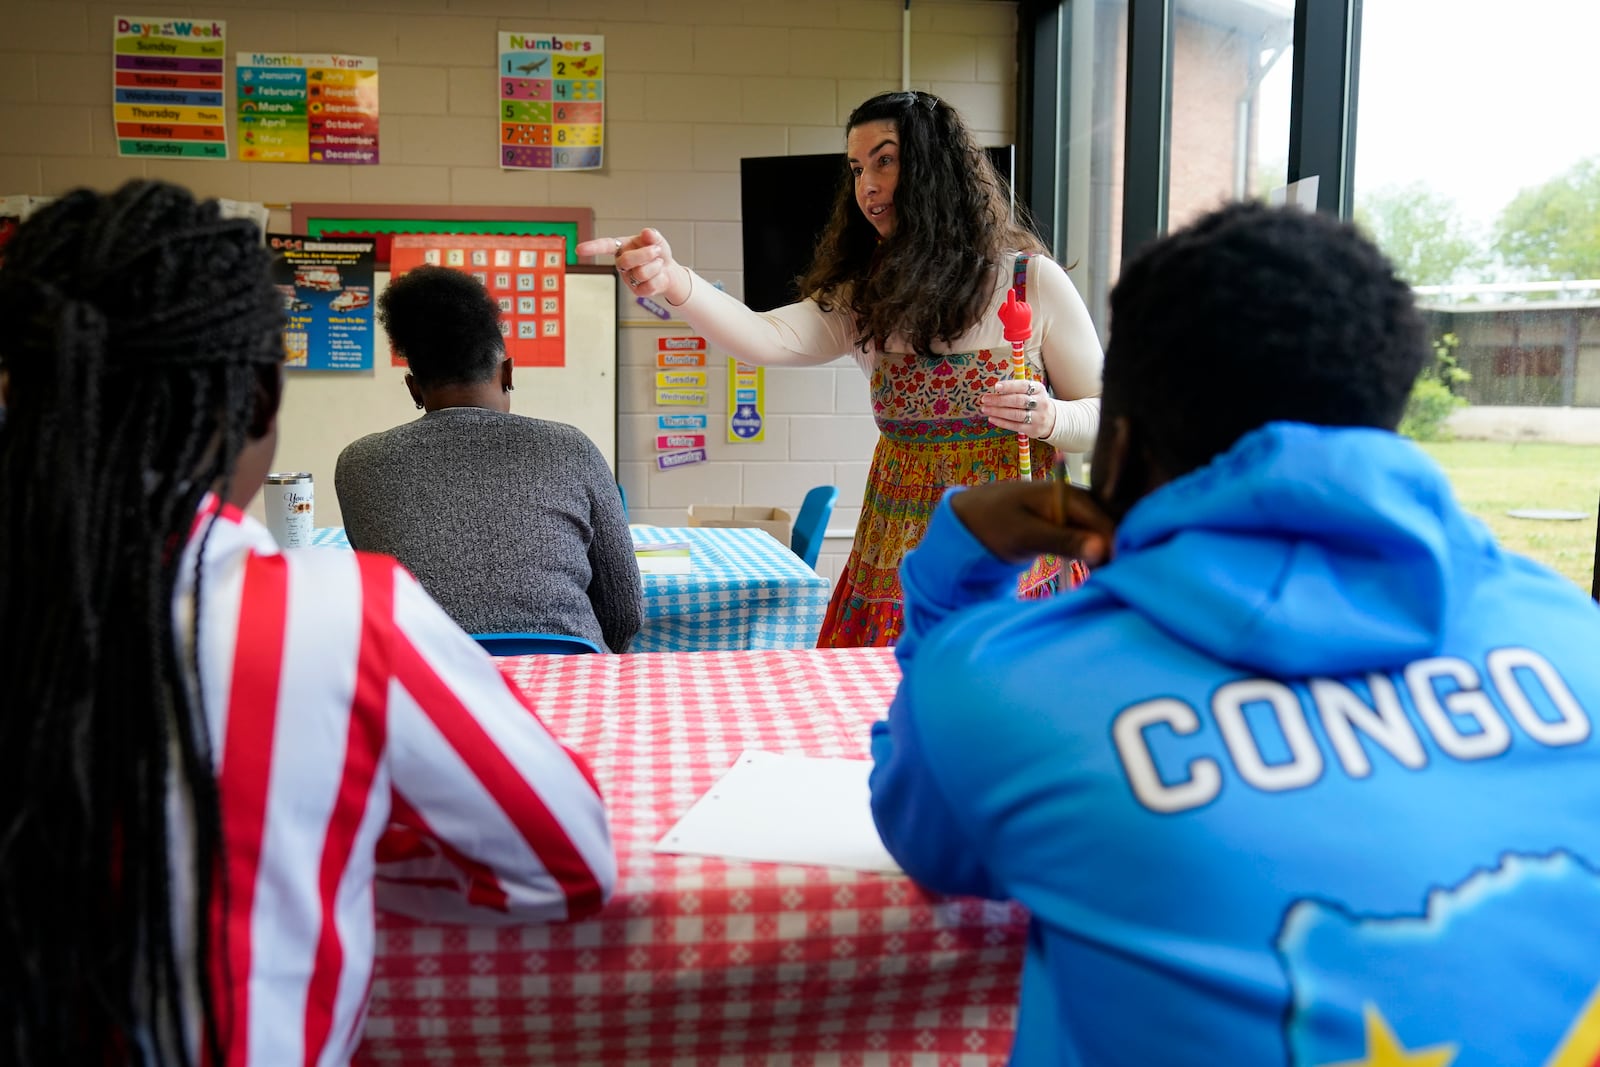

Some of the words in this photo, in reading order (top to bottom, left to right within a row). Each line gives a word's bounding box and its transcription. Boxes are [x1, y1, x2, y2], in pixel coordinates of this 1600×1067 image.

[118, 19, 160, 38] Days
[173, 22, 221, 37] Week
[137, 41, 177, 53] Sunday
[510, 35, 591, 51] Numbers
[253, 54, 303, 66] Months
[331, 56, 362, 68] Year
[507, 60, 511, 73] 1
[557, 62, 565, 75] 2
[134, 74, 177, 87] Tuesday
[259, 71, 301, 82] January
[327, 71, 344, 81] July
[259, 86, 306, 98] February
[325, 87, 359, 98] August
[506, 82, 514, 96] 3
[556, 84, 566, 97] 4
[124, 91, 187, 103] Wednesday
[259, 102, 293, 112] March
[506, 105, 514, 118] 5
[132, 107, 180, 120] Thursday
[558, 107, 566, 120] 6
[261, 118, 286, 128] April
[326, 120, 364, 130] October
[141, 125, 173, 136] Friday
[506, 128, 514, 140] 7
[558, 129, 566, 142] 8
[261, 135, 282, 144] May
[326, 134, 374, 145] November
[136, 142, 183, 155] Saturday
[262, 150, 285, 158] June
[326, 149, 374, 160] December
[506, 150, 514, 163] 9
[556, 152, 569, 165] 10
[452, 254, 458, 262] 2
[550, 255, 556, 264] 6
[499, 277, 506, 285] 11
[522, 278, 530, 287] 12
[546, 278, 554, 287] 13
[522, 301, 531, 310] 19
[545, 301, 555, 310] 20
[522, 325, 532, 334] 26
[546, 323, 555, 332] 27
[667, 339, 698, 350] Sunday
[665, 355, 698, 365] Monday
[664, 375, 699, 385] Tuesday
[660, 393, 704, 402] Wednesday
[664, 417, 702, 427] Thursday
[668, 437, 695, 447] Friday
[663, 451, 702, 465] Saturday
[1112, 646, 1592, 813] CONGO
